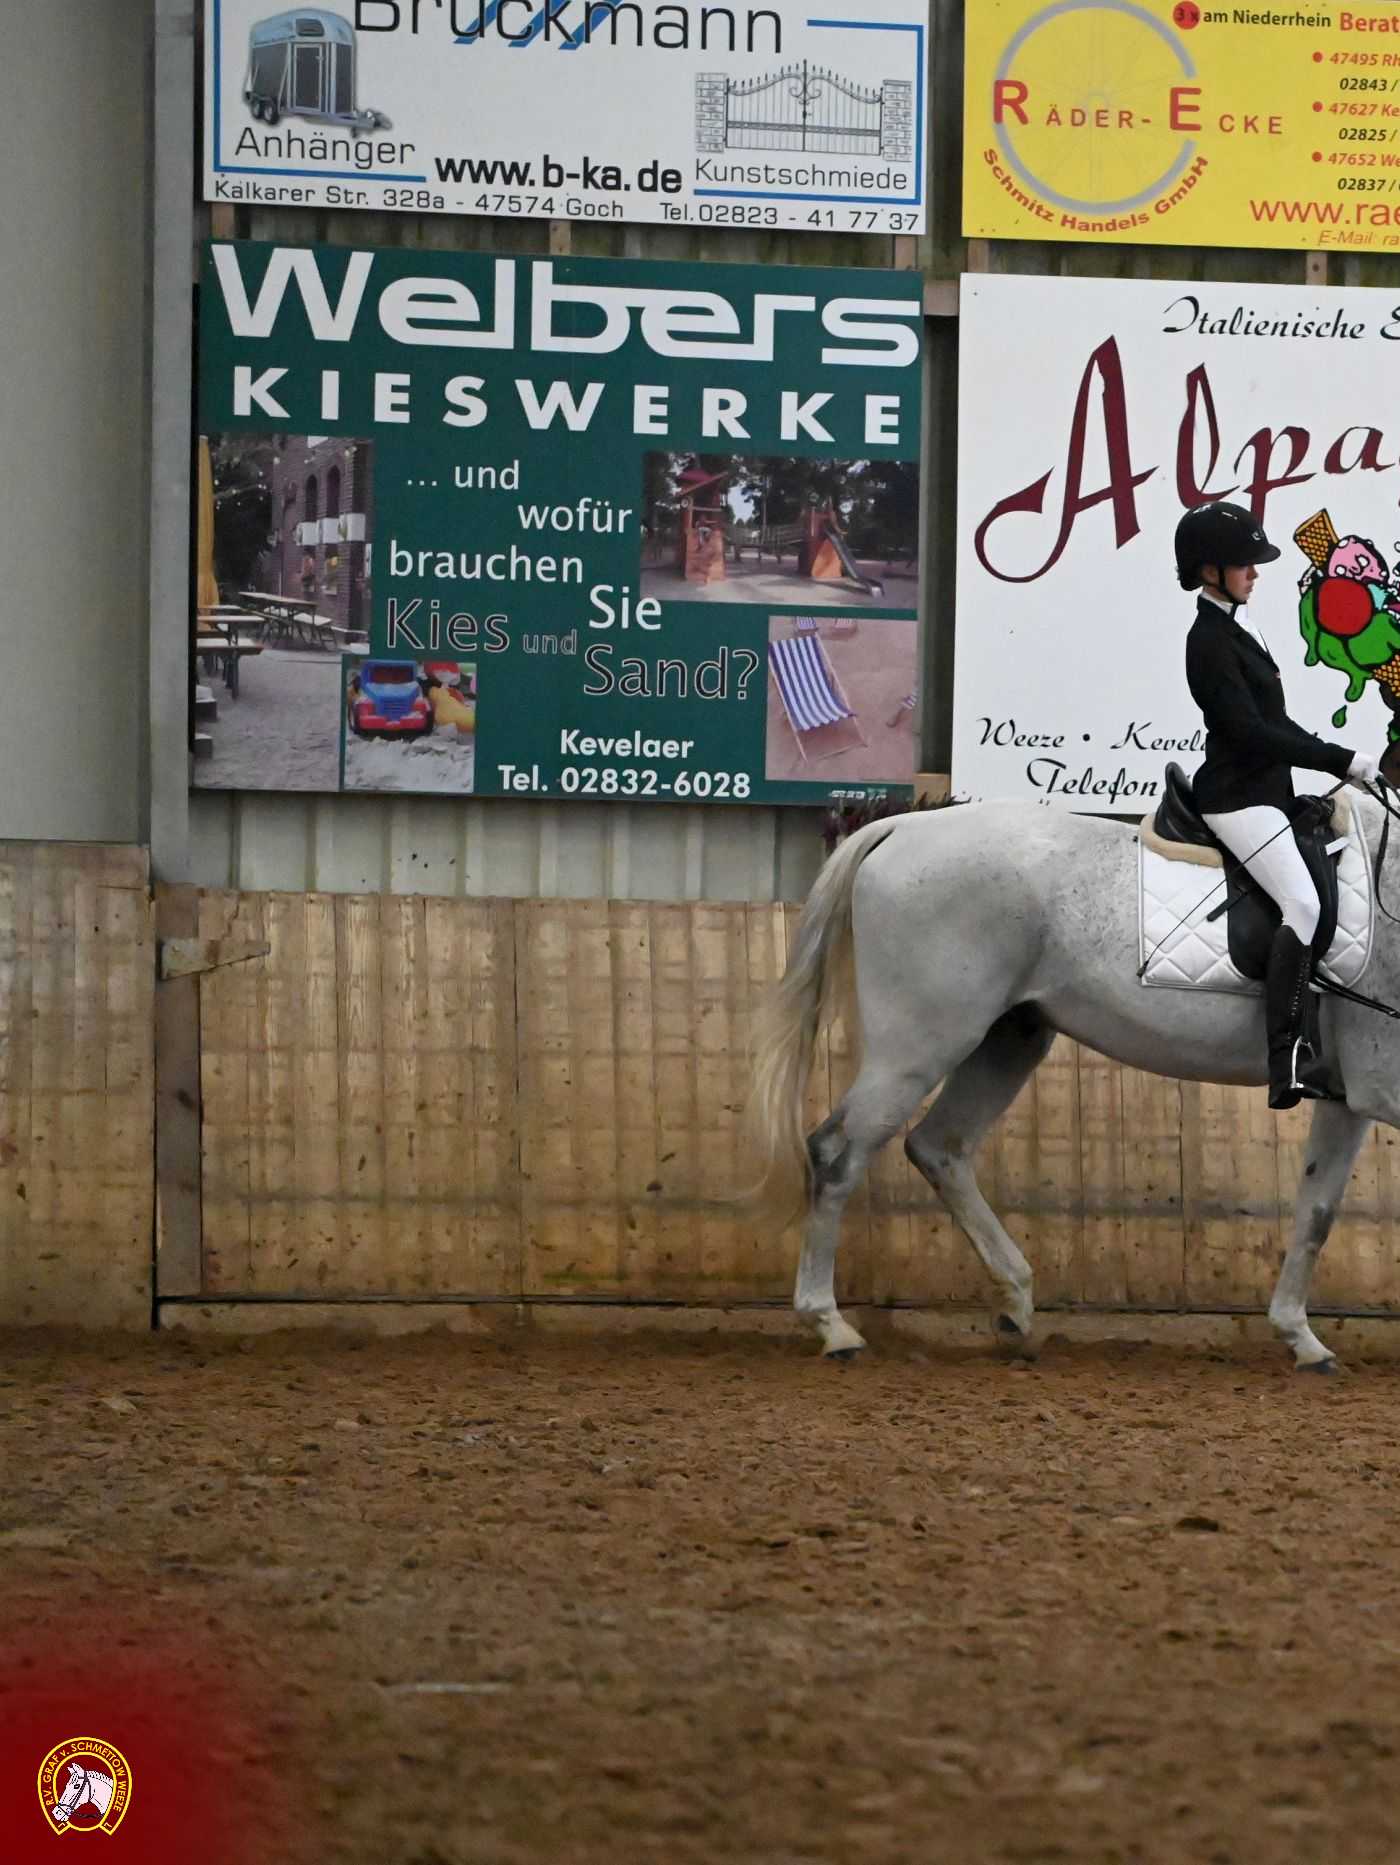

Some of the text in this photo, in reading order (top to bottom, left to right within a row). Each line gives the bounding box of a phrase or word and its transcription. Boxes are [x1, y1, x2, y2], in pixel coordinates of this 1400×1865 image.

[1203, 12, 1229, 24] am
[1233, 9, 1331, 29] Niederrhein
[1329, 52, 1378, 66] 47495
[1339, 77, 1388, 92] 02843
[1328, 102, 1378, 116] 47627
[234, 126, 416, 170] Anhänger
[1338, 127, 1387, 142] 02825
[695, 158, 908, 191] Kunstschmiede
[1328, 152, 1377, 166] 47652
[215, 179, 316, 202] Kalkarer
[326, 186, 370, 206] Str.
[383, 188, 445, 210] 328a
[475, 194, 556, 215] 47574
[566, 198, 624, 218] Goch
[983, 148, 1209, 232] Schmitz Handels GmbH
[1337, 177, 1386, 192] 02837
[807, 210, 835, 227] 41
[849, 211, 878, 229] 77
[890, 213, 919, 231] 37
[209, 243, 921, 367] Welbers
[1162, 296, 1366, 340] Italienische
[232, 365, 901, 445] KIESWERKE
[453, 460, 520, 491] und
[518, 498, 633, 534] wofür
[389, 541, 584, 584] brauchen
[588, 584, 662, 631] Sie
[388, 598, 759, 700] Kies und Sand?
[559, 728, 695, 759] Kevelaer
[977, 717, 1206, 752] Weeze Kevel
[498, 764, 751, 799] Tel. 02832-6028
[1026, 757, 1158, 803] Telefon
